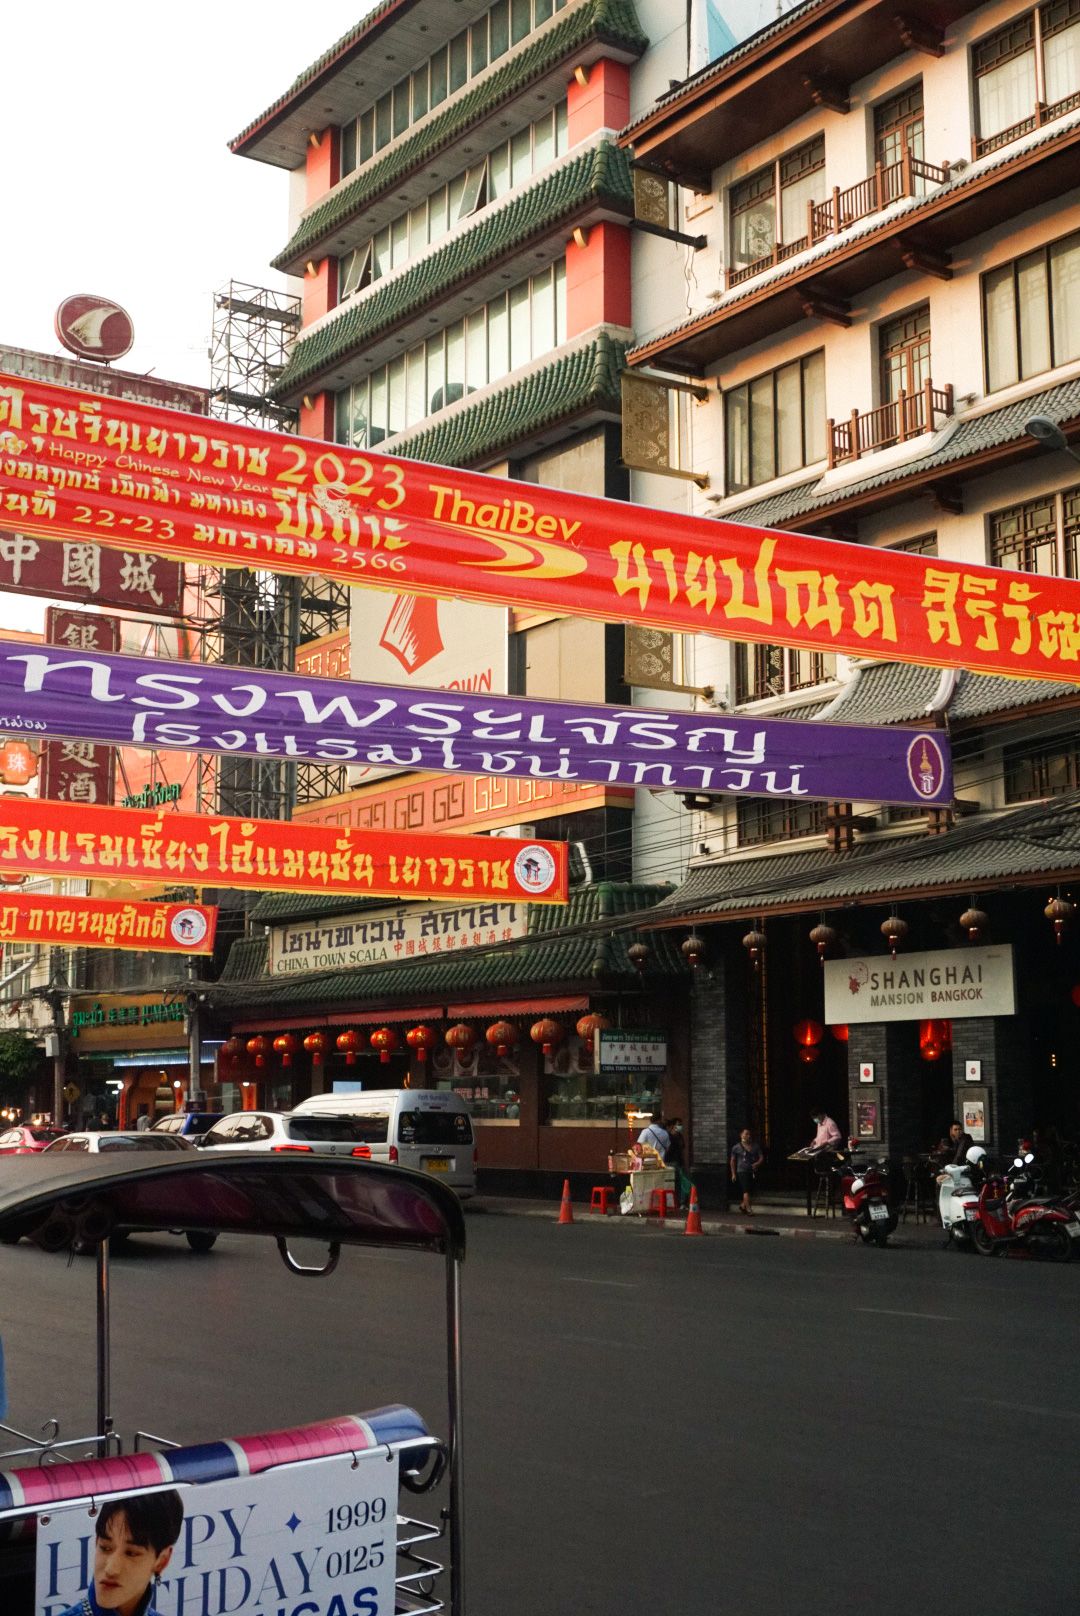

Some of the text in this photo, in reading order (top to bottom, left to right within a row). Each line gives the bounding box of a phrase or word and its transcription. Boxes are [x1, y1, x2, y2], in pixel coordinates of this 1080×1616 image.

[0, 459, 100, 492] งคลฤกษ์
[50, 442, 270, 494] Happy Chinese New Year
[276, 444, 406, 510] 2023
[429, 484, 582, 541] ThaiBev
[73, 506, 176, 539] 22-23
[193, 520, 317, 559] มกราคม
[331, 548, 406, 572] 2566
[0, 534, 163, 606] 中國城
[59, 623, 99, 650] 銀
[6, 655, 767, 764] ทรงพระเจริญ
[389, 855, 511, 889] เยาวราช
[420, 903, 517, 937] สกาลา
[277, 947, 388, 972] CHINA TOWN SCALA
[870, 964, 983, 991] SHANGHAI
[870, 988, 984, 1007] MANSION BANGKOK
[325, 1497, 387, 1534] 1999
[46, 1504, 257, 1598] HPY
[326, 1539, 385, 1579] 0125
